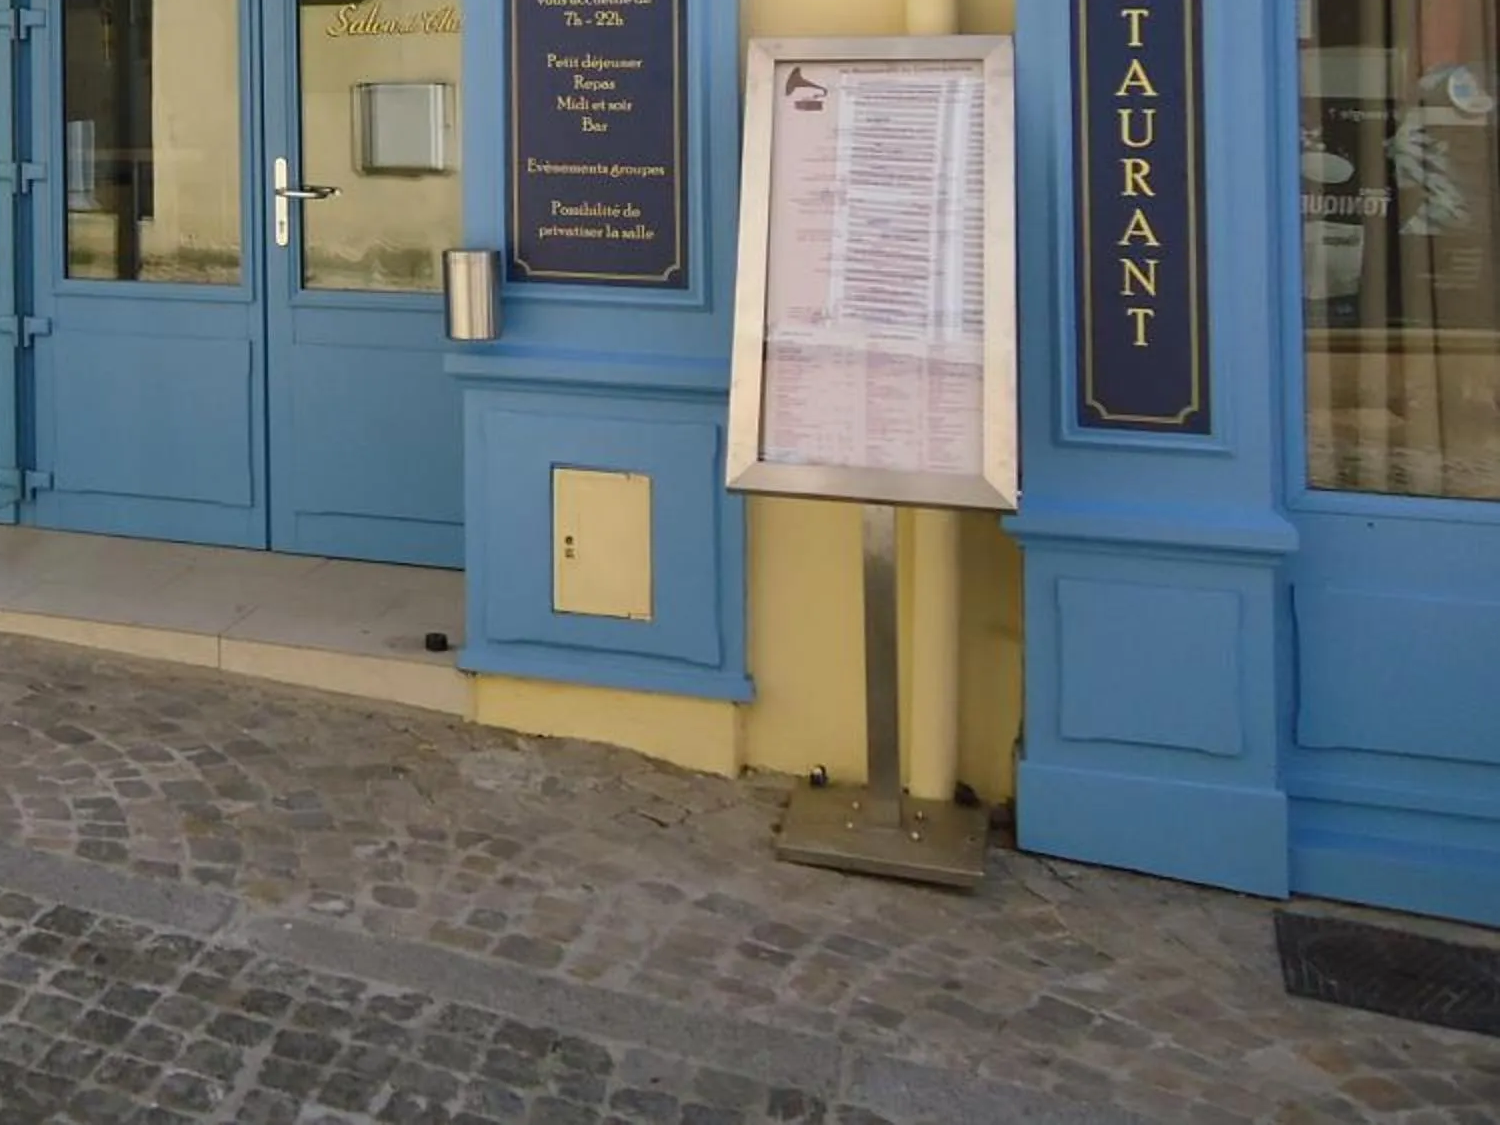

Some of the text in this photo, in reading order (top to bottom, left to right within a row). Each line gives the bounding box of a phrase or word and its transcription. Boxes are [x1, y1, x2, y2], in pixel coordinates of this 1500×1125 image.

[564, 11, 583, 26] 7h
[595, 11, 625, 26] 22h
[547, 53, 579, 68] Petit
[574, 74, 616, 91] Repas
[556, 96, 633, 111] Midi et soir
[581, 116, 609, 132] Bar
[610, 163, 665, 178] groupes
[551, 200, 641, 217] Possibilité de
[539, 224, 655, 240] privatiser la salle
